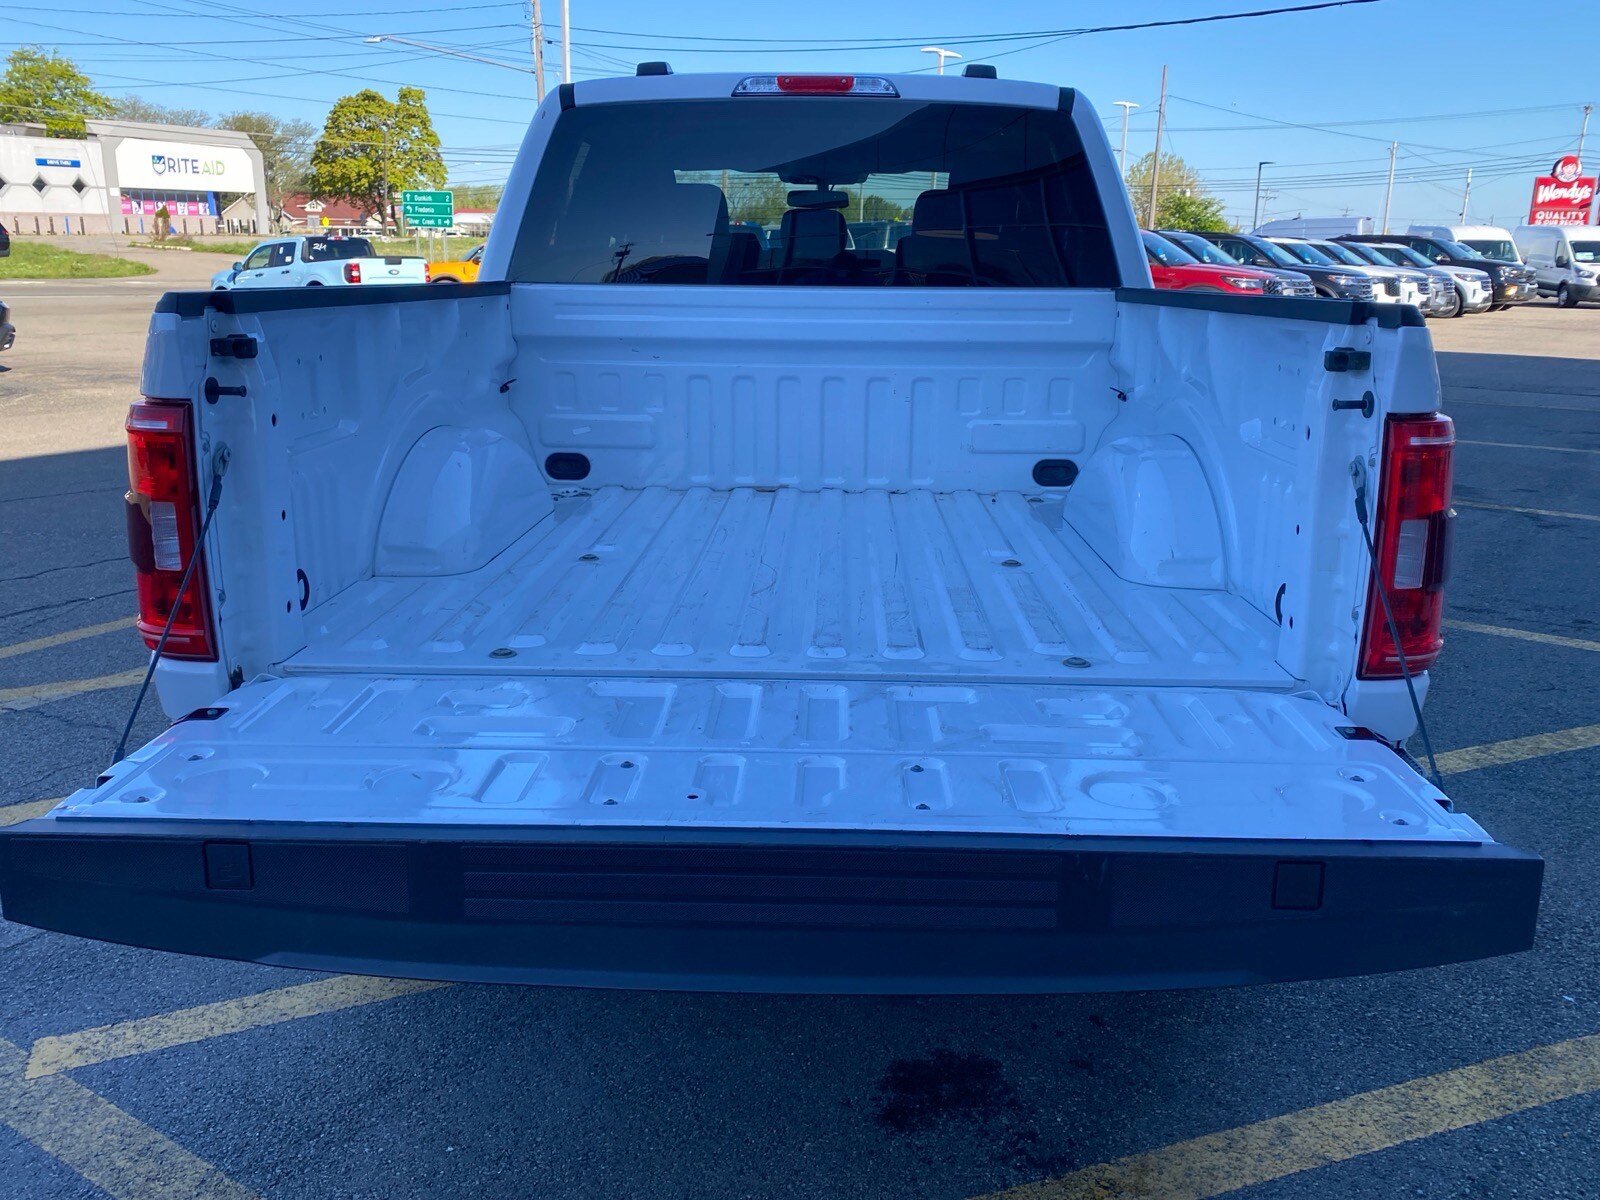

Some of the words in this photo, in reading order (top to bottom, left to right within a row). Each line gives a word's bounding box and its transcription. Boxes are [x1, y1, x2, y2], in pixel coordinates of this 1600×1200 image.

[167, 157, 200, 174] RITE
[201, 160, 225, 175] AID
[1536, 181, 1592, 204] Wendy's
[1535, 211, 1586, 220] QUALITY
